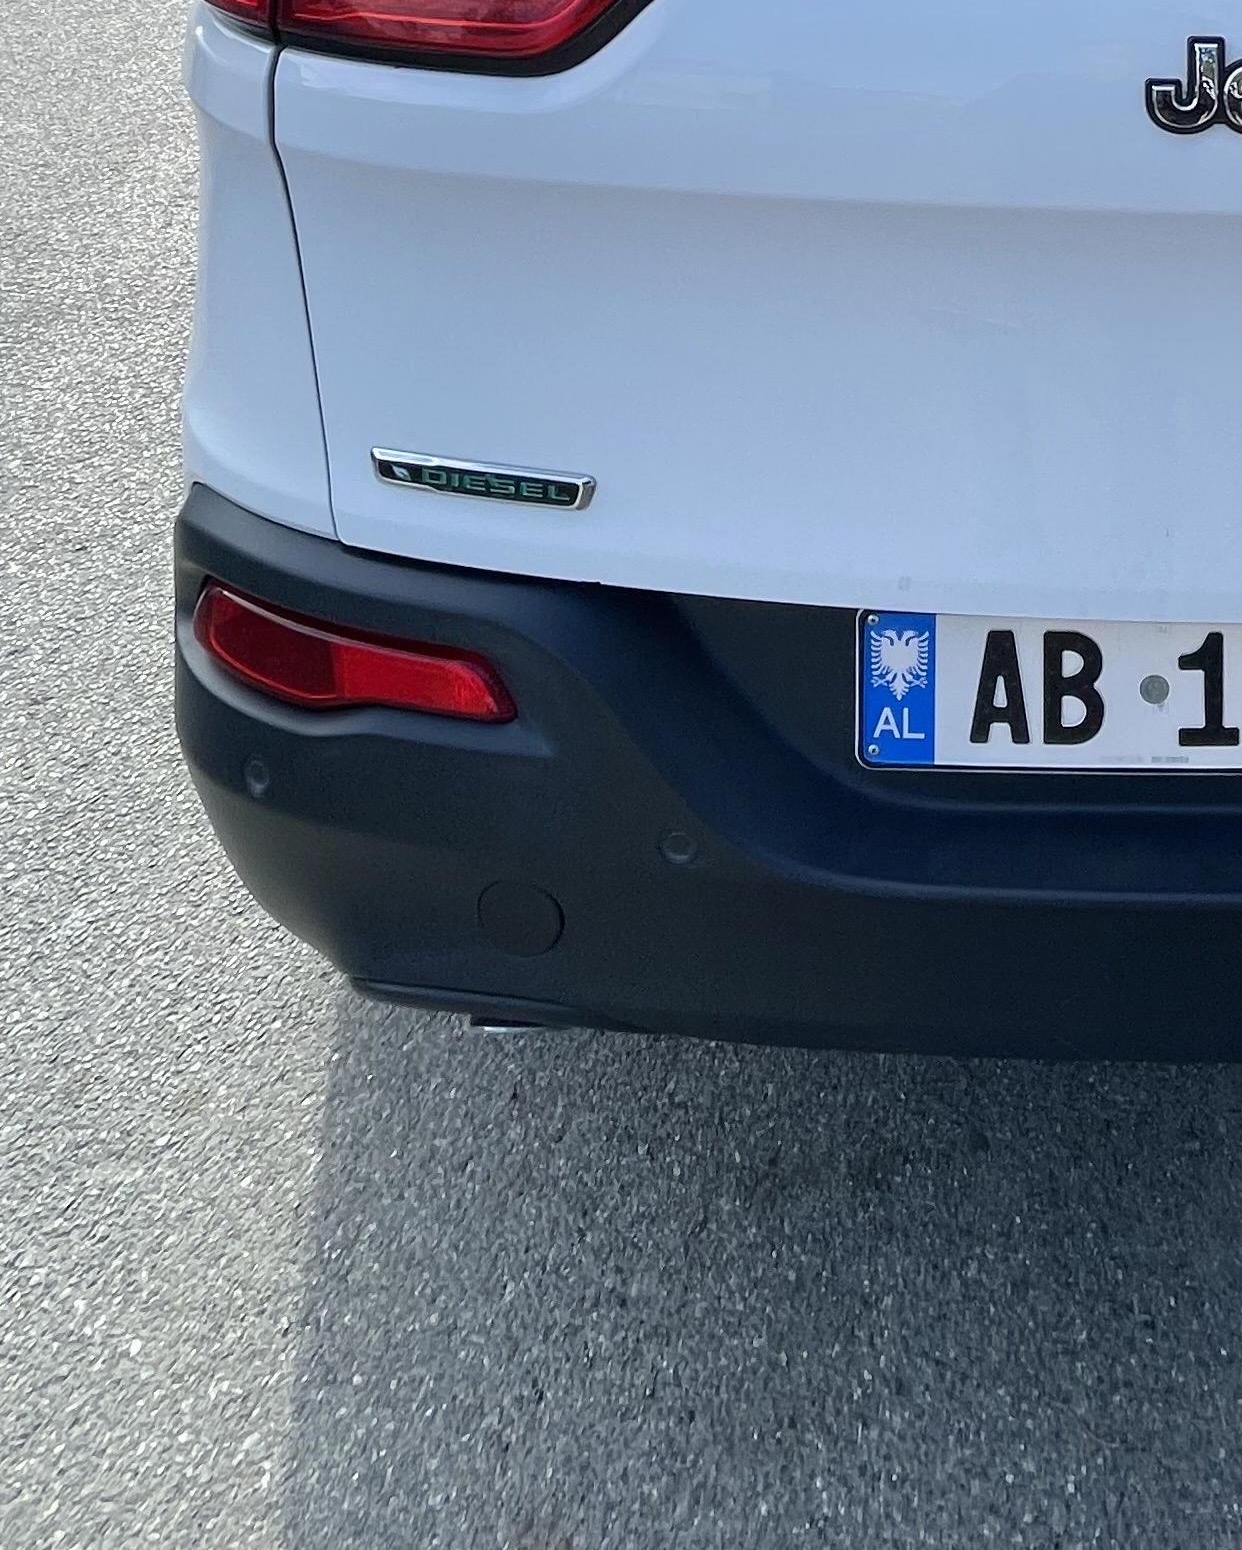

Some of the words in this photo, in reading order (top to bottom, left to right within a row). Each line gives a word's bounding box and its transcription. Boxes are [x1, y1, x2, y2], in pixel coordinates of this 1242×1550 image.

[421, 466, 572, 502] DIESEL
[968, 629, 1107, 746] AB
[872, 706, 926, 740] AL
